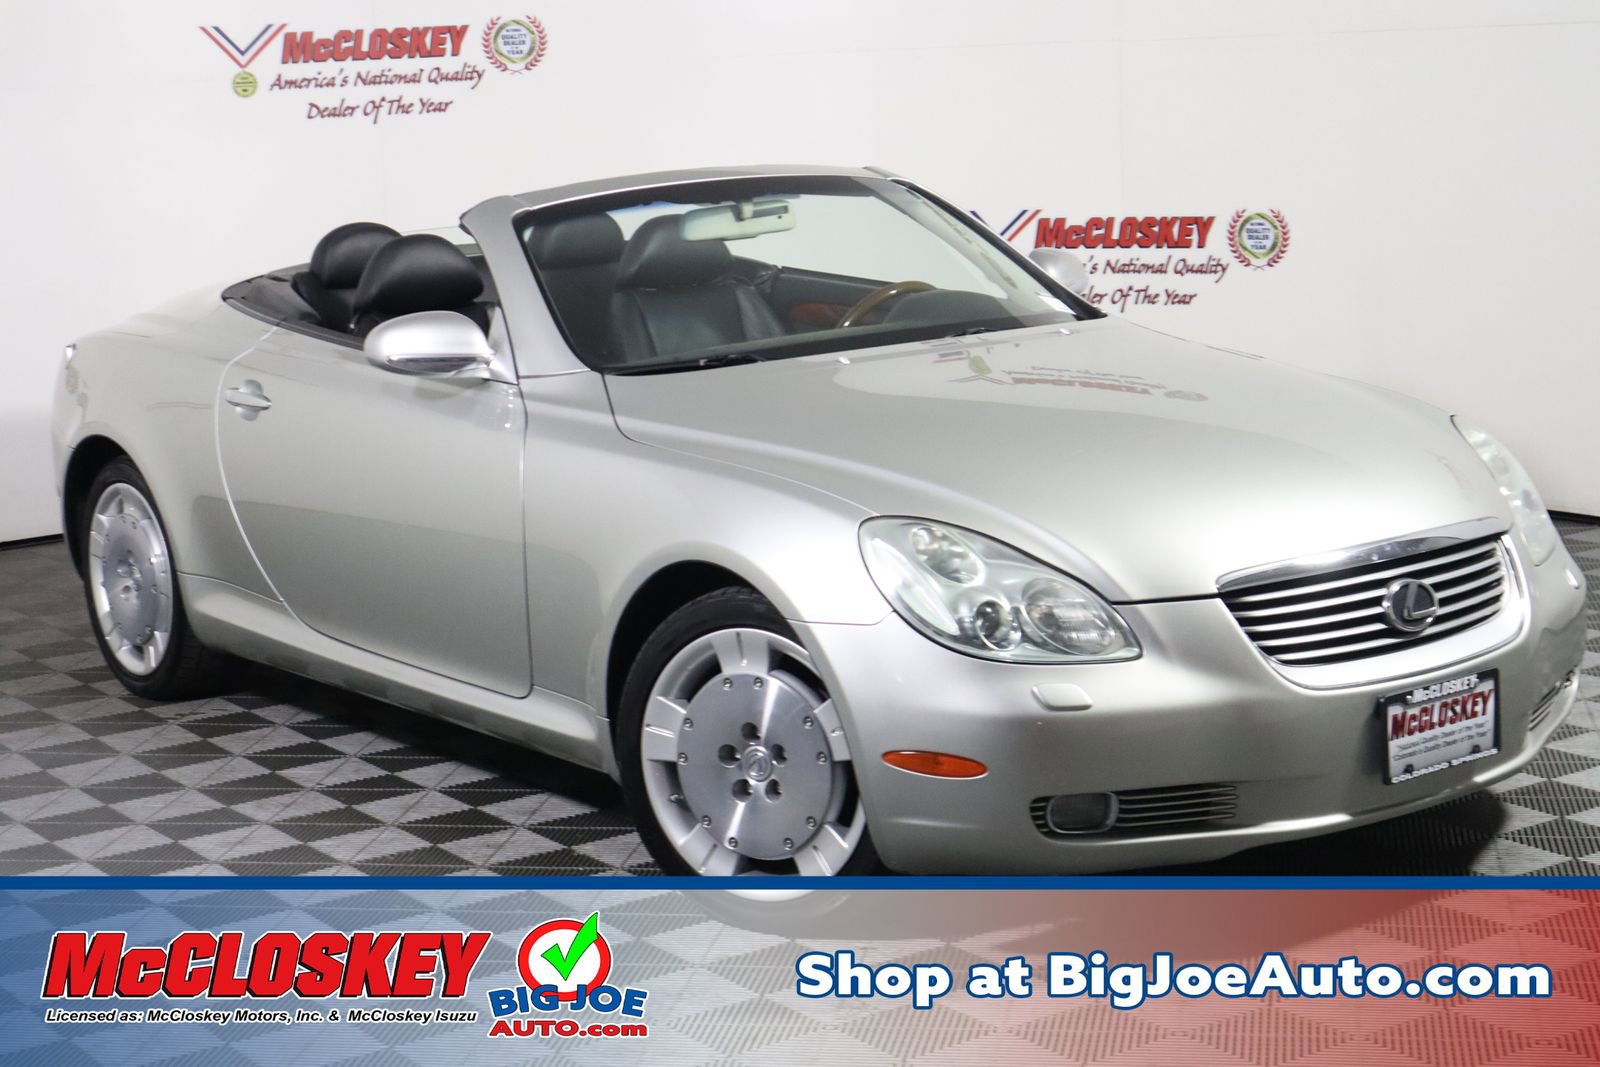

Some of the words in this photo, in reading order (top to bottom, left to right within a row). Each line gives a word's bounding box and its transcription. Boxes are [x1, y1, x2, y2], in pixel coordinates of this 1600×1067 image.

[281, 25, 469, 64] McCLOSKEY
[269, 68, 348, 91] America's
[354, 68, 424, 87] National
[428, 63, 486, 90] Quality
[307, 98, 360, 119] Dealer
[363, 96, 386, 125] Of
[387, 95, 415, 116] The
[418, 97, 453, 115] Year
[1035, 216, 1216, 249] McCLOSKEY
[1103, 255, 1172, 275] National
[1173, 255, 1230, 284] Quality
[1111, 285, 1133, 313] Of
[1134, 285, 1160, 305] The
[1164, 289, 1198, 306] Year
[1390, 689, 1492, 741] McCLOSKEY
